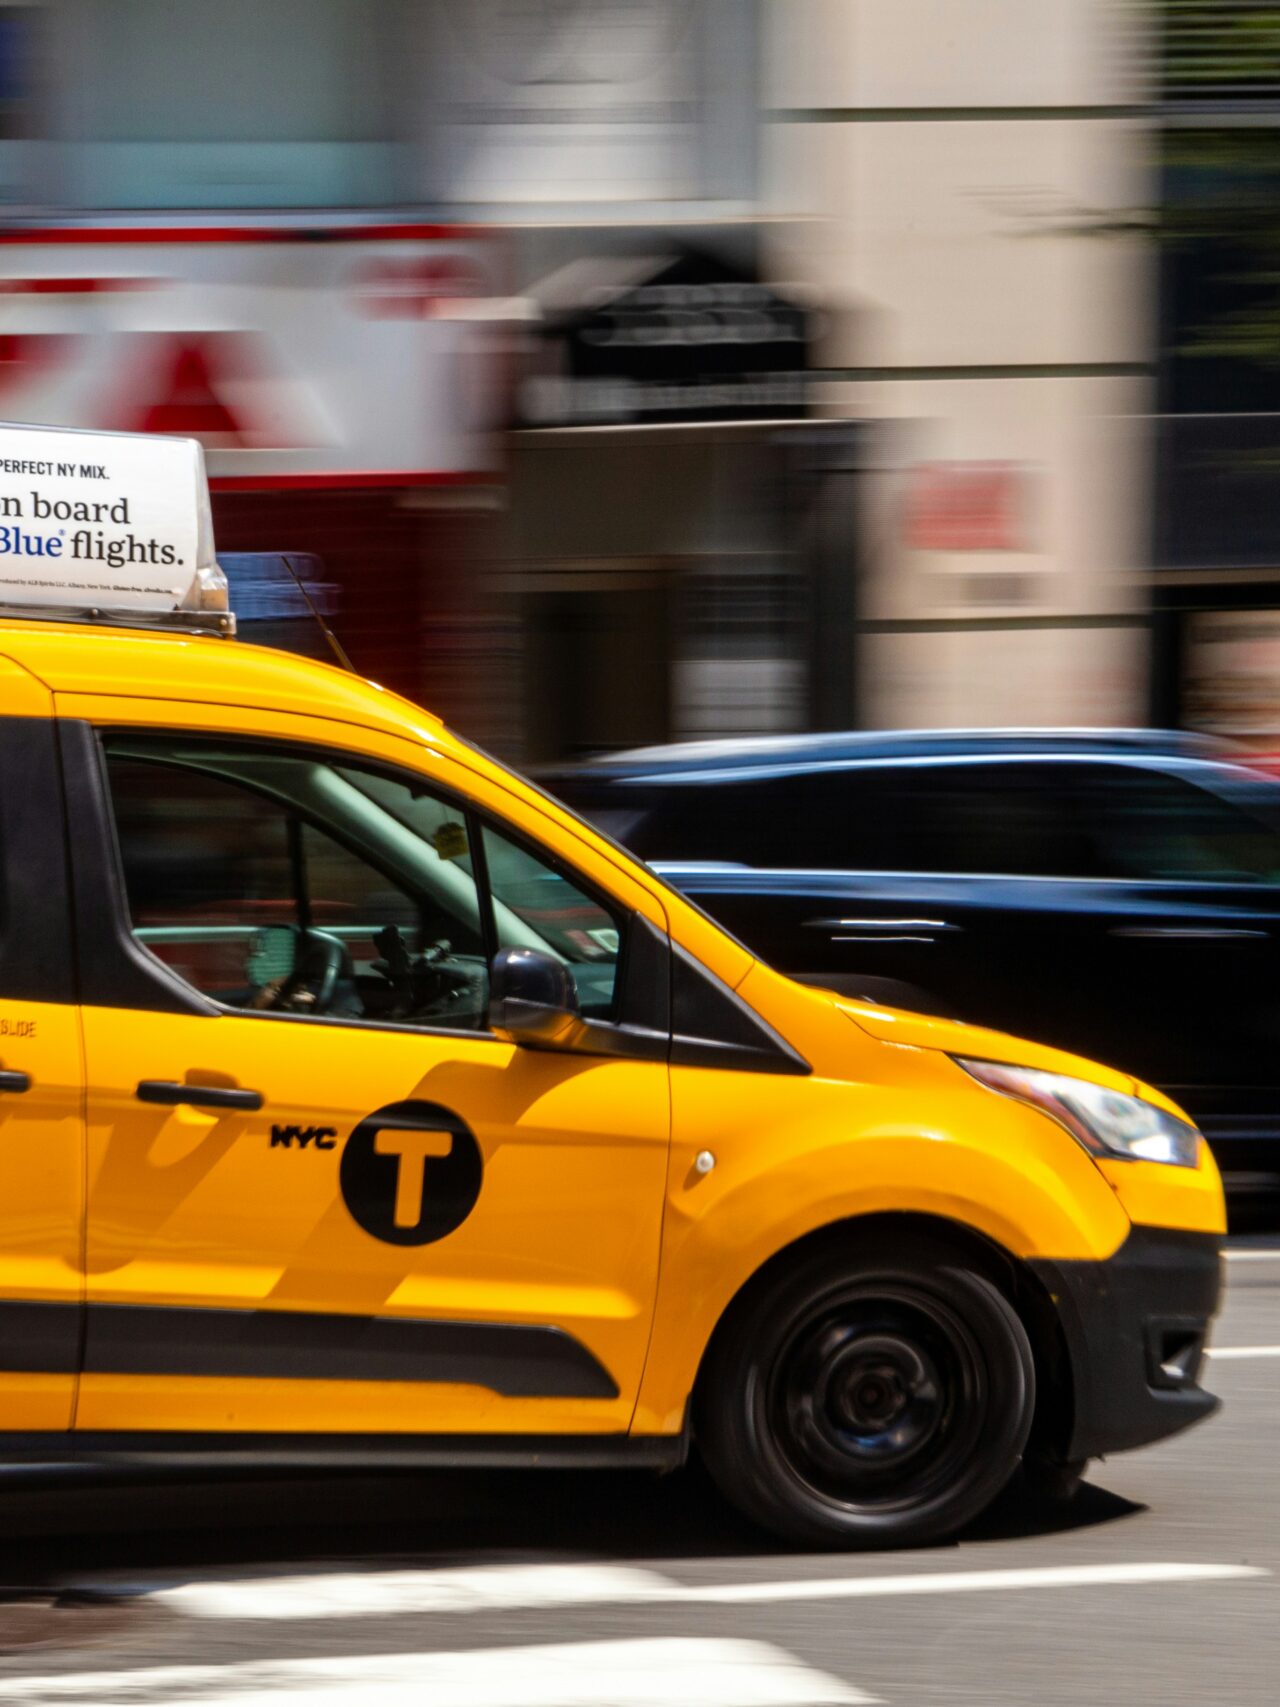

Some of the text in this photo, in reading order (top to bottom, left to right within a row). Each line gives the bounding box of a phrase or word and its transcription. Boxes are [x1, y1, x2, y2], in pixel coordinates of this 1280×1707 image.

[57, 463, 76, 477] NY
[80, 465, 110, 480] MIX.
[30, 491, 132, 525] board
[70, 530, 184, 569] flights.
[0, 1018, 37, 1038] SLIDE
[271, 1124, 453, 1229] NYC T
